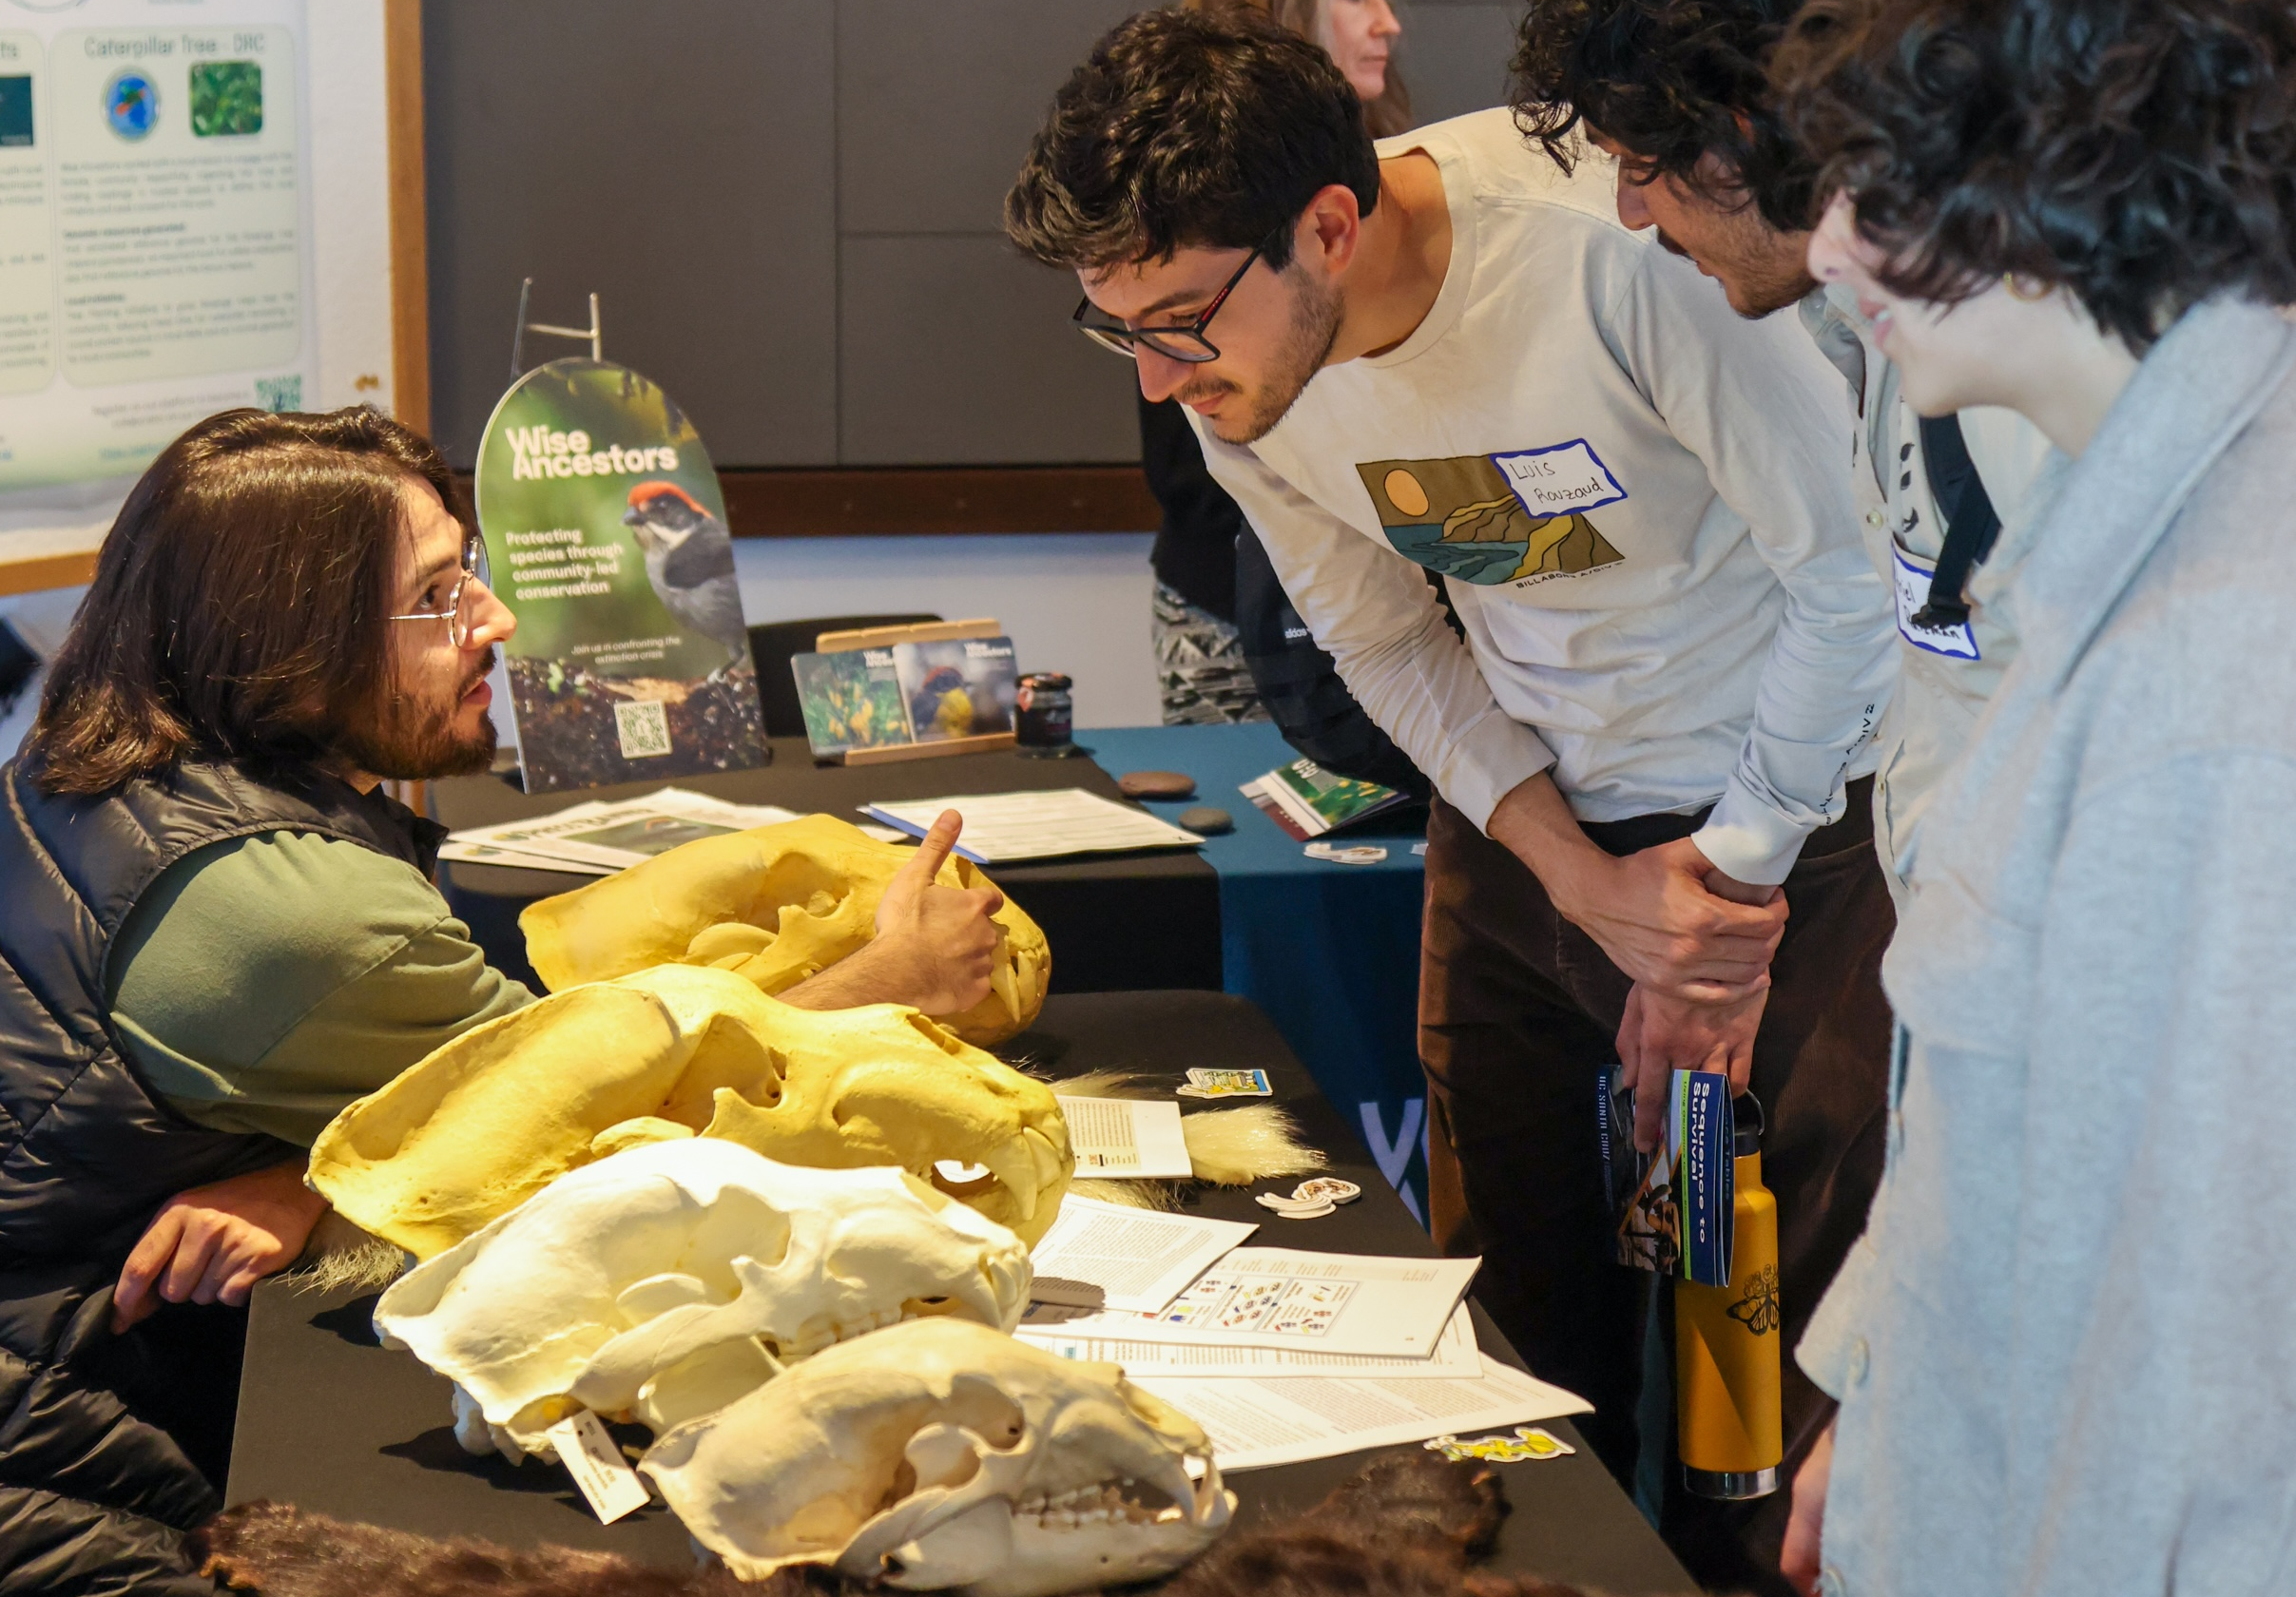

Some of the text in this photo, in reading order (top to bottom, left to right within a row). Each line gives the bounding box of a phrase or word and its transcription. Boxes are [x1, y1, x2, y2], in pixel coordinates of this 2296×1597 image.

[84, 35, 174, 58] Caterpillar
[505, 424, 591, 456] Wise
[512, 443, 680, 481] Ancestors
[506, 529, 584, 547] Protecting
[510, 542, 624, 567] species through
[512, 559, 620, 583] community-led
[515, 581, 611, 601] conservation
[571, 636, 681, 656] Join us in confronting the
[594, 650, 664, 664] extinction crisis
[1598, 1094, 1608, 1129] SANTA
[1691, 1081, 1702, 1181] Survival
[1698, 1082, 1710, 1243] Sequence to
